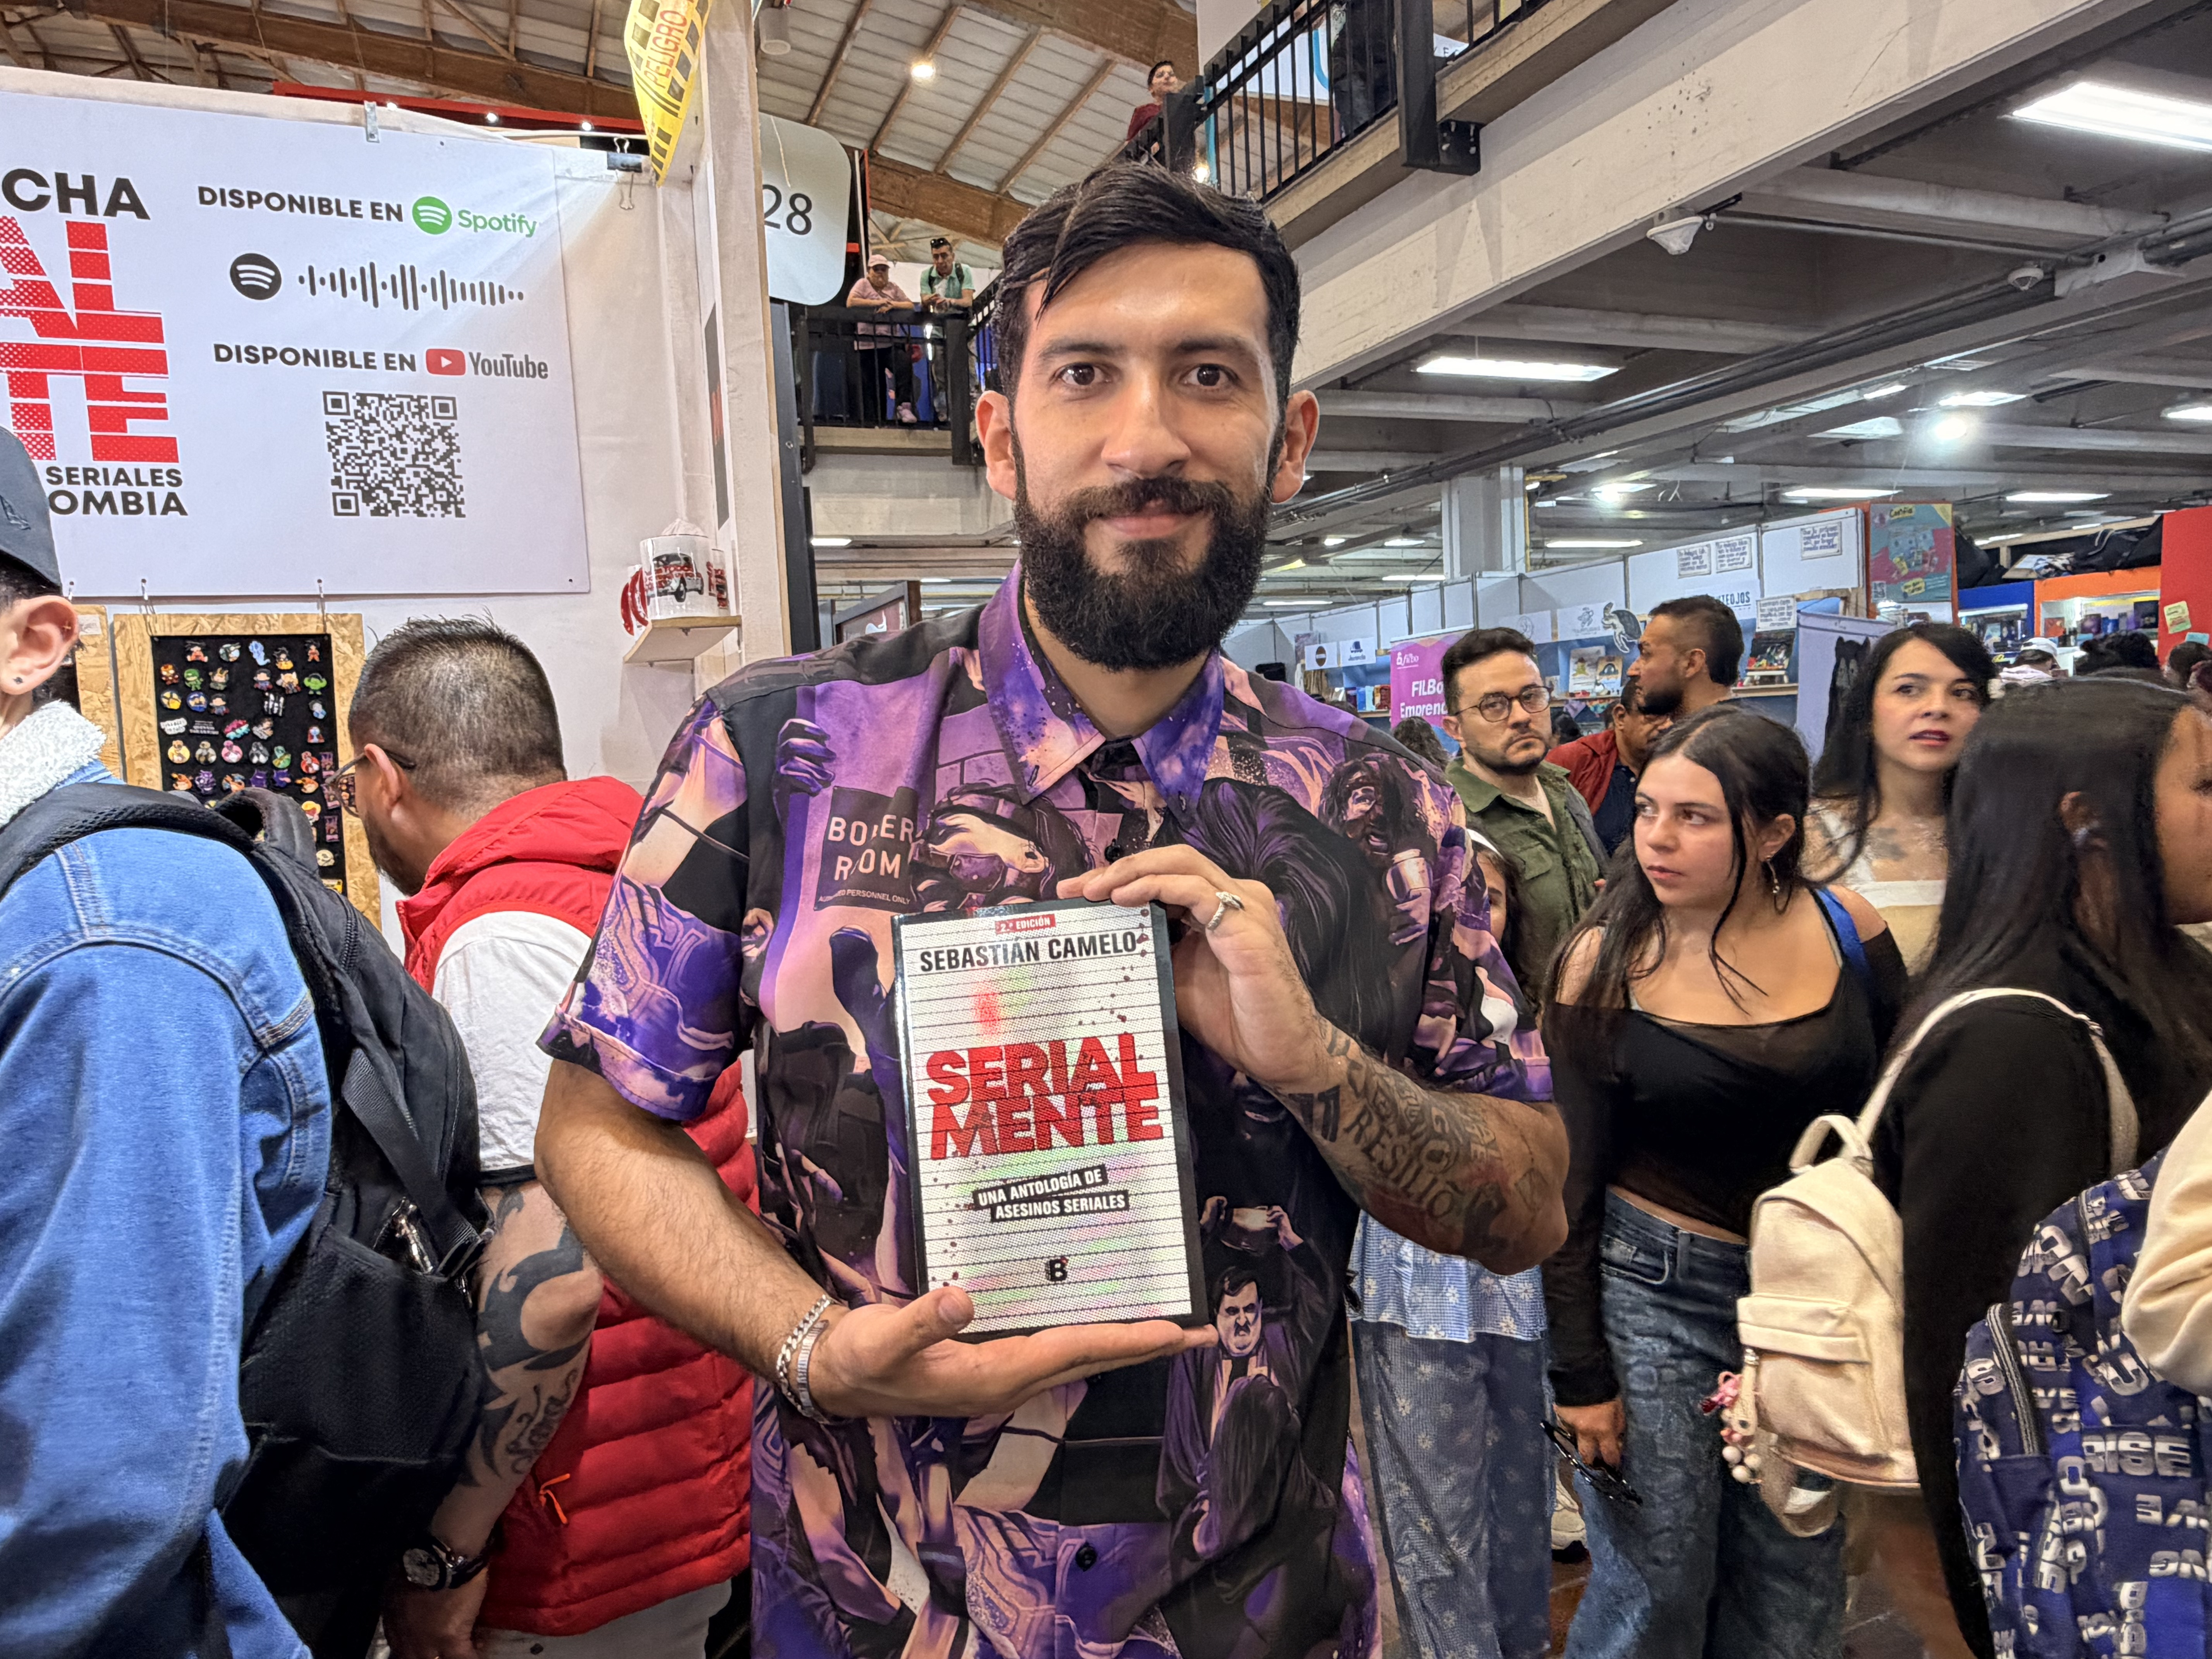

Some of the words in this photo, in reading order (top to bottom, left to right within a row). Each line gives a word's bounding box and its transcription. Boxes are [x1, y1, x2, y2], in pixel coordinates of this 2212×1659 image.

[644, 10, 687, 89] PELIGRO
[2, 168, 151, 220] CHA
[198, 186, 363, 219] DISPONIBLE
[371, 201, 404, 222] EN
[458, 210, 537, 237] Spotify
[762, 184, 812, 235] 28
[214, 343, 376, 371] DISPONIBLE
[384, 353, 416, 372] EN
[469, 352, 548, 379] YouTube
[46, 466, 183, 487] SERIALES
[1719, 591, 1750, 605] TEOJOS
[847, 889, 891, 902] PERSONNEL
[892, 895, 910, 905] ONLY
[1016, 917, 1051, 930] EDICIÓN
[1048, 931, 1136, 960] CAMELO
[926, 1032, 1159, 1105] SERIAL
[931, 1089, 1163, 1159] MENTE
[978, 1188, 1007, 1206] UNA
[1010, 1170, 1082, 1200] ANTOLOGÍA
[1084, 1169, 1103, 1185] DE
[996, 1200, 1060, 1219] ASESINOS
[1064, 1194, 1125, 1212] SERIALES
